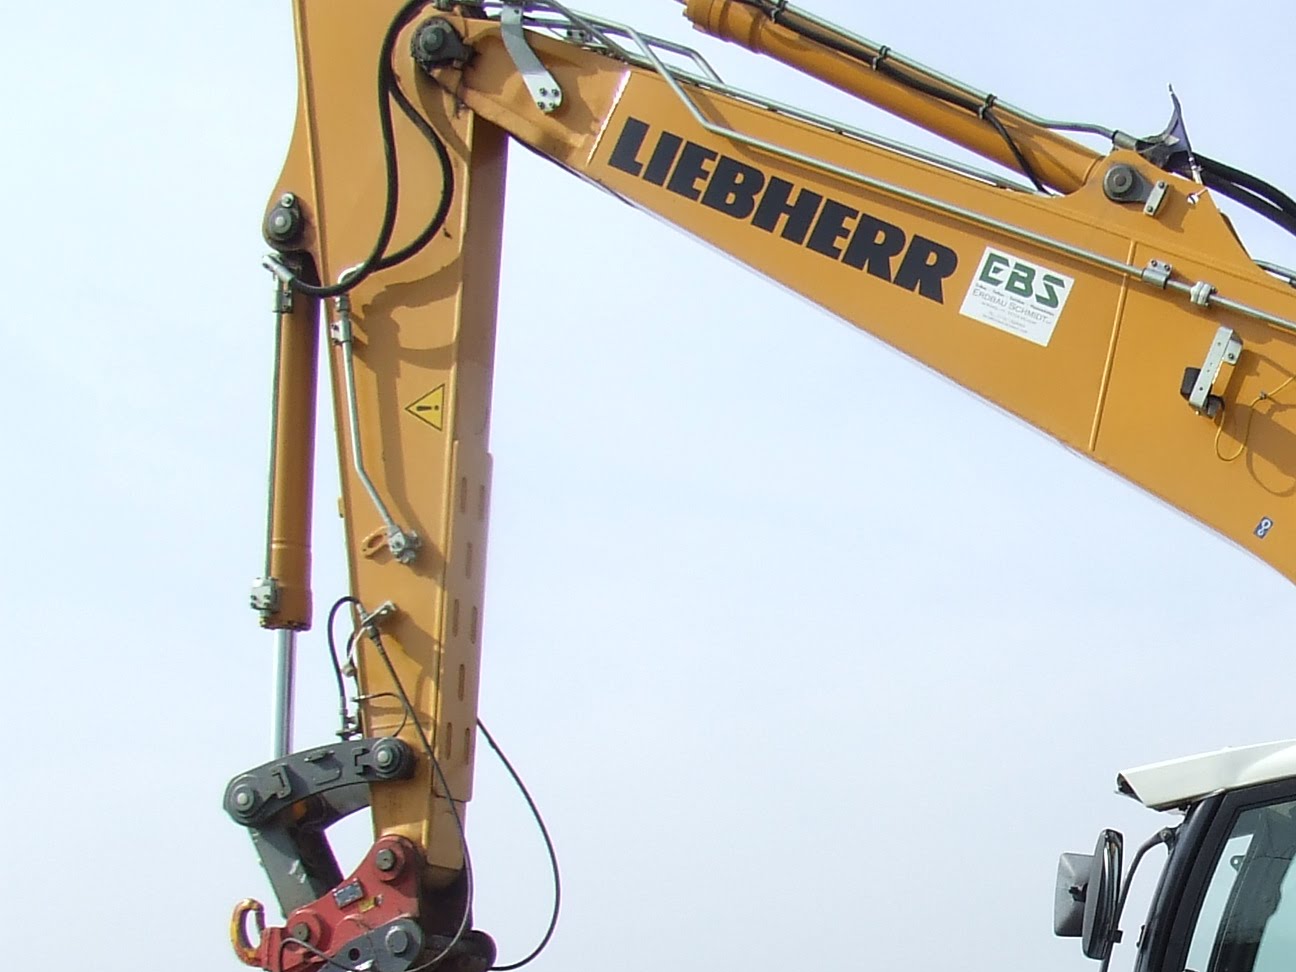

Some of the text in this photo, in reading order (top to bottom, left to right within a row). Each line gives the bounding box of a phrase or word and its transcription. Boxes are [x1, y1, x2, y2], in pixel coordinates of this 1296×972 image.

[607, 116, 959, 305] LIEBHERR
[979, 252, 1065, 309] EBS
[1008, 301, 1048, 323] SCHMIDT
